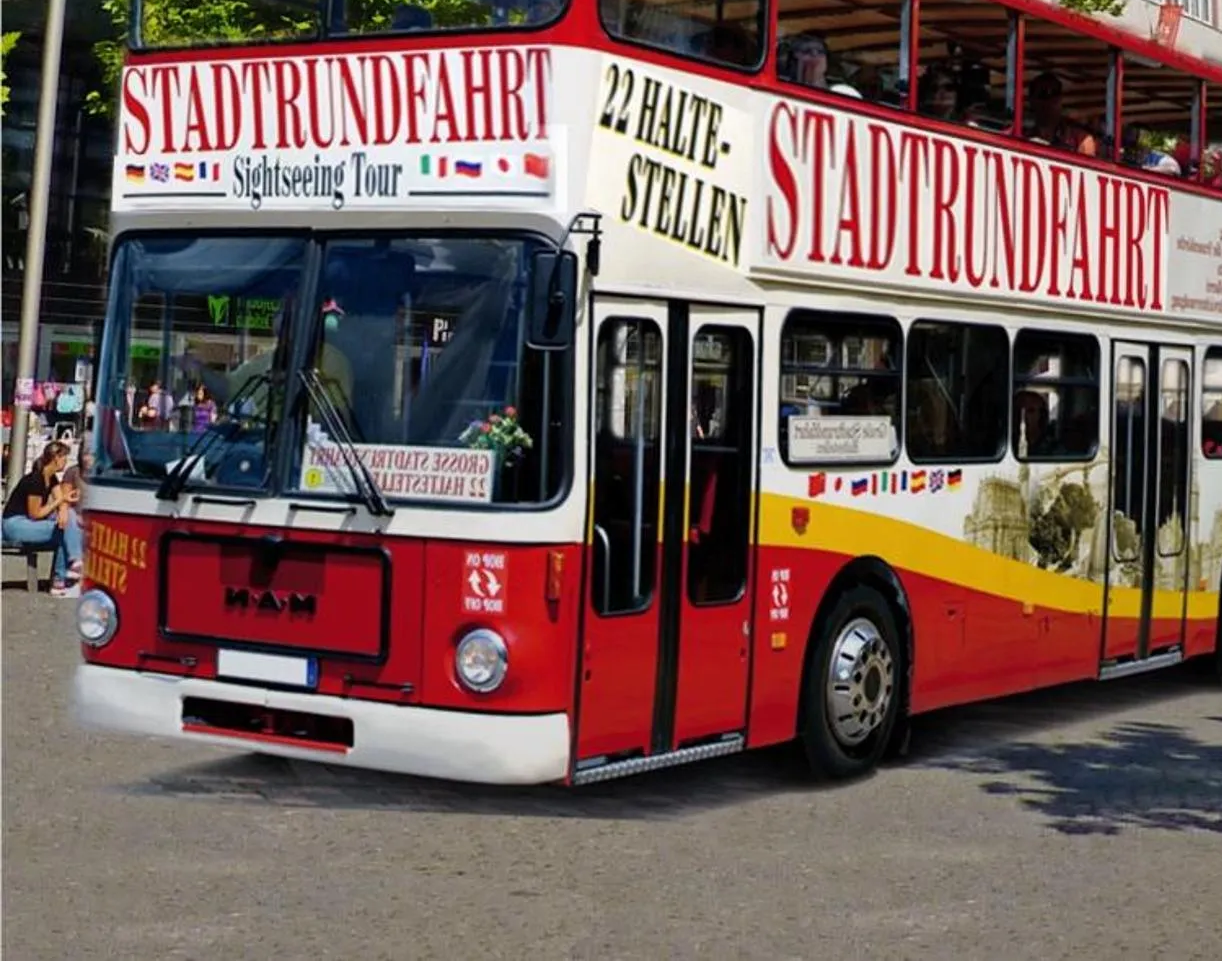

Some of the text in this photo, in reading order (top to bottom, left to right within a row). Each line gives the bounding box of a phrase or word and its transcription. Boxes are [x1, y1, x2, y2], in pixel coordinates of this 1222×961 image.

[122, 48, 552, 156] STADTRUNDFAHRT
[599, 62, 635, 134] 22
[232, 150, 403, 208] Sightseeing Tour
[620, 153, 748, 268] STELLEN
[766, 100, 1171, 312] STADTRUNDFAHRT
